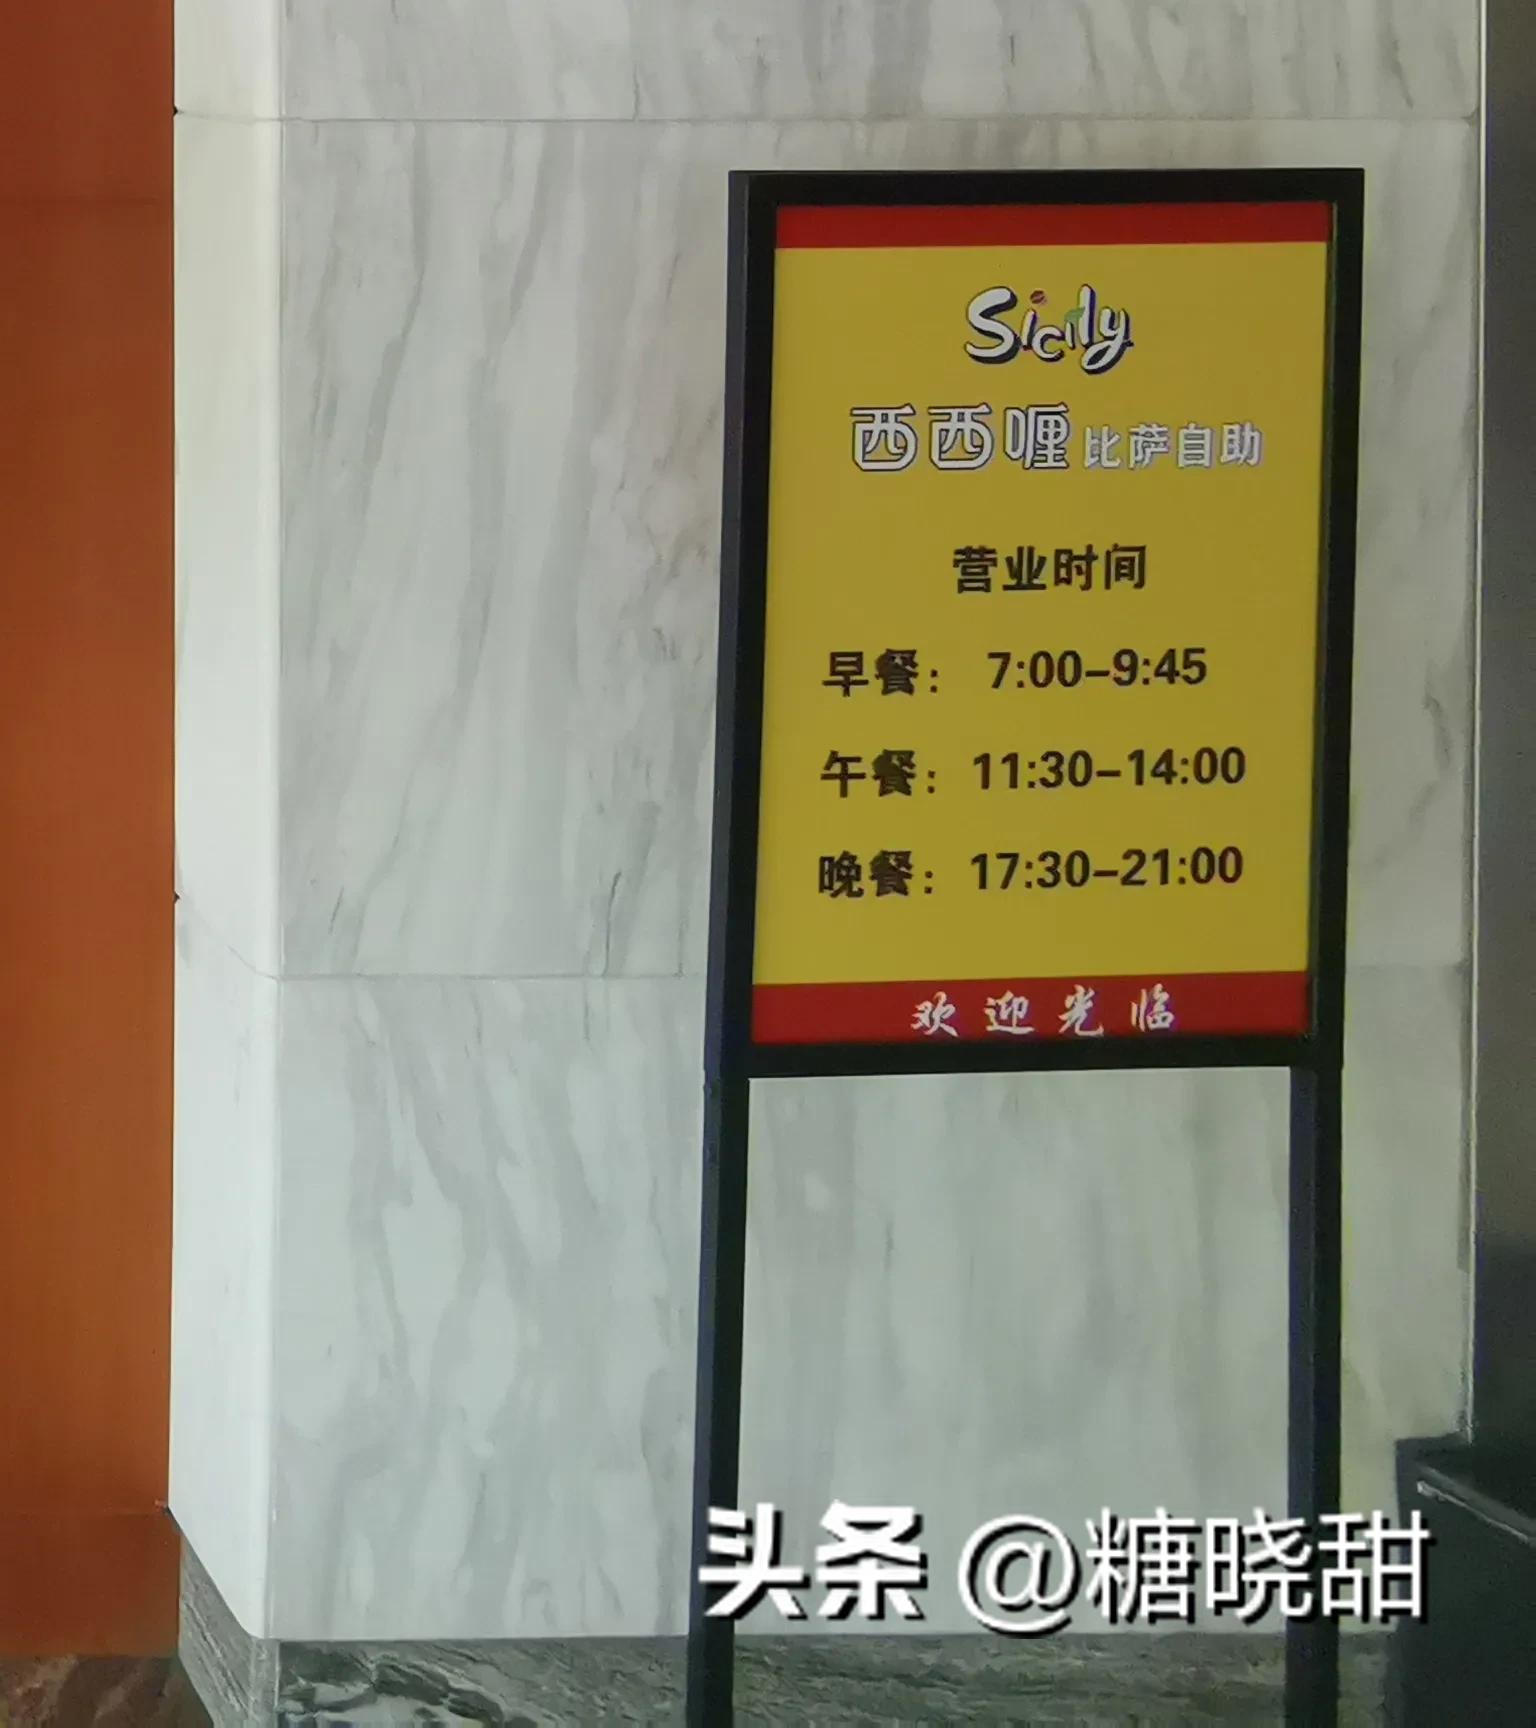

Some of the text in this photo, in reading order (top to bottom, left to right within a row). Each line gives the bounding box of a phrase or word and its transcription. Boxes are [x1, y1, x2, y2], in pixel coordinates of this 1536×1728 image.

[962, 284, 1134, 374] Sicily
[848, 402, 1264, 472] 西西喱 比萨自助
[952, 543, 1148, 593] 营业时间
[986, 647, 1208, 688] 7:00-9:45
[971, 746, 1248, 790] 11:30-14:00
[969, 846, 1245, 891] 17:30-21:00
[909, 984, 1178, 1040] 欢迎光临
